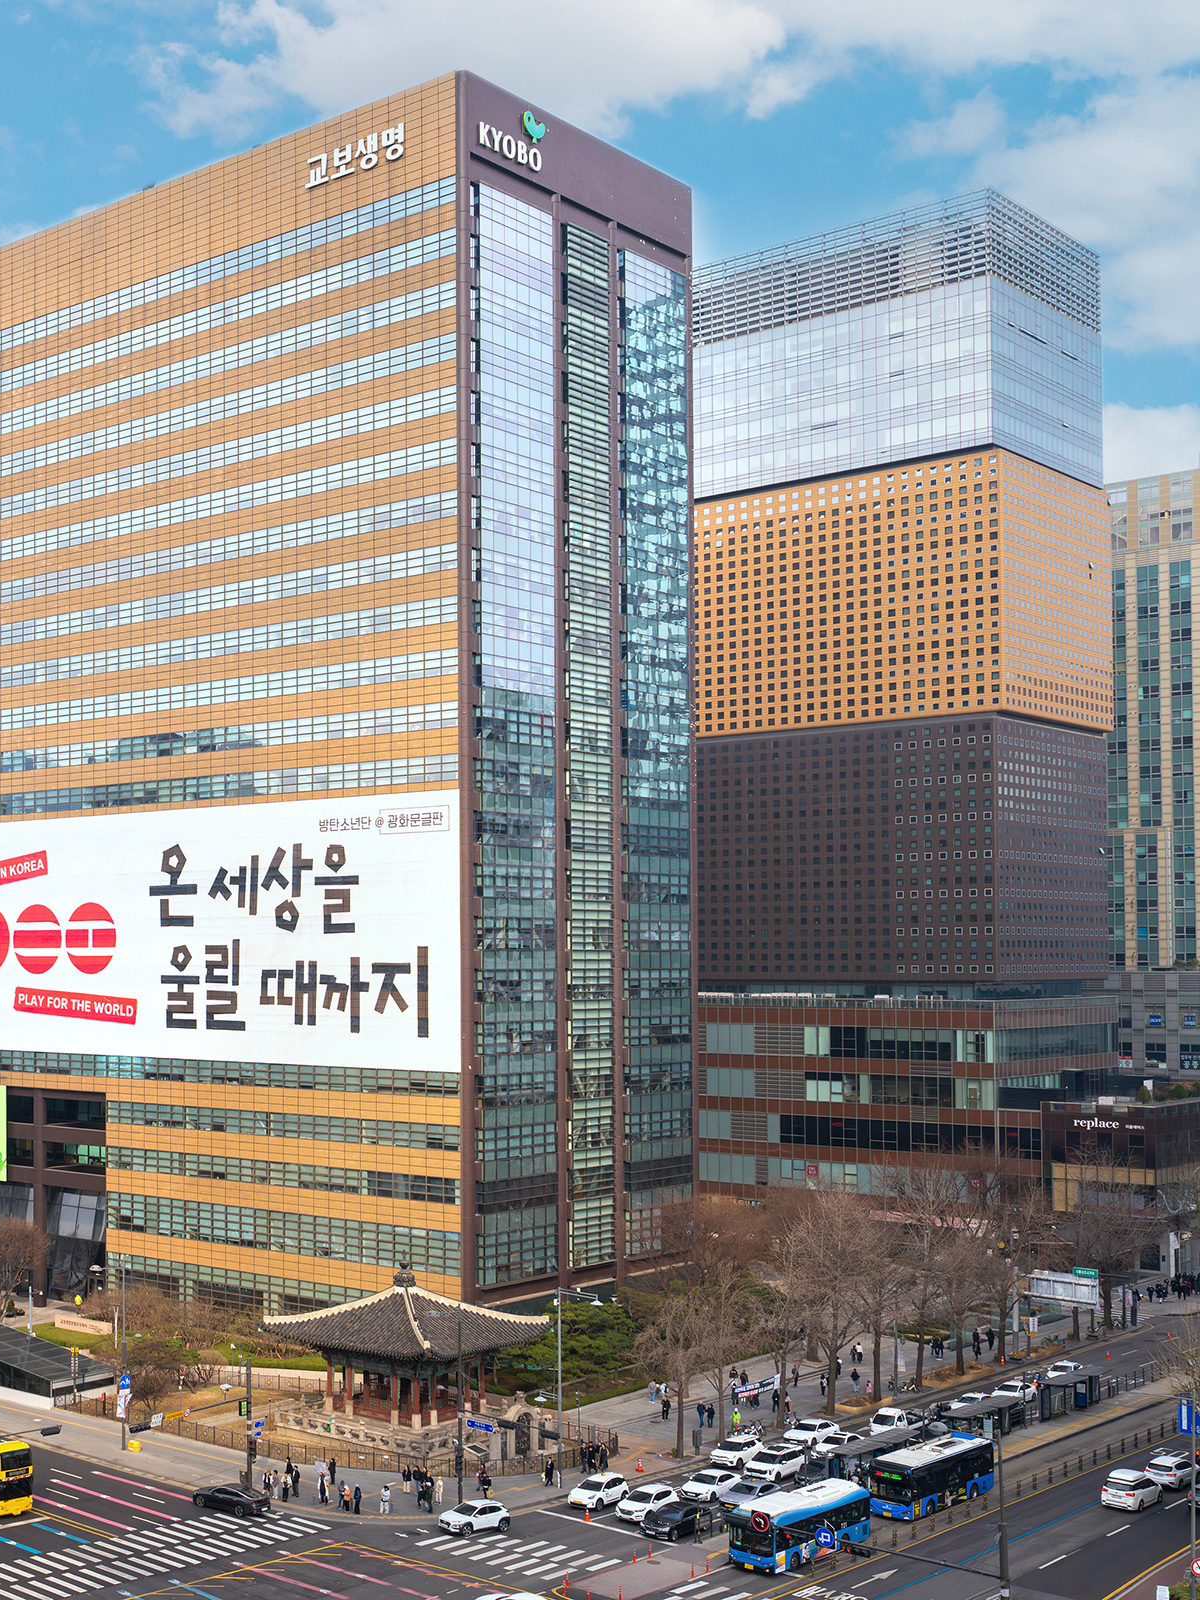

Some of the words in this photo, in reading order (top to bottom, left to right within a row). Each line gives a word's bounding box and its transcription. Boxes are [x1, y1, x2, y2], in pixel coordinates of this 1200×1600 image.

[305, 122, 406, 189] 교보생명
[479, 121, 543, 172] KYOBO
[318, 816, 372, 833] 방탄소년단
[387, 811, 444, 829] 광화문글판
[9, 858, 45, 876] KOREA
[149, 843, 198, 928] 온
[207, 843, 360, 935] 세상을
[18, 993, 45, 1007] PLAY
[47, 996, 68, 1010] FOR
[71, 999, 91, 1013] THE
[94, 1001, 134, 1017] WORLD
[160, 938, 246, 1032] 울릴
[259, 945, 429, 1039] 때까지
[1073, 1117, 1120, 1130] replace
